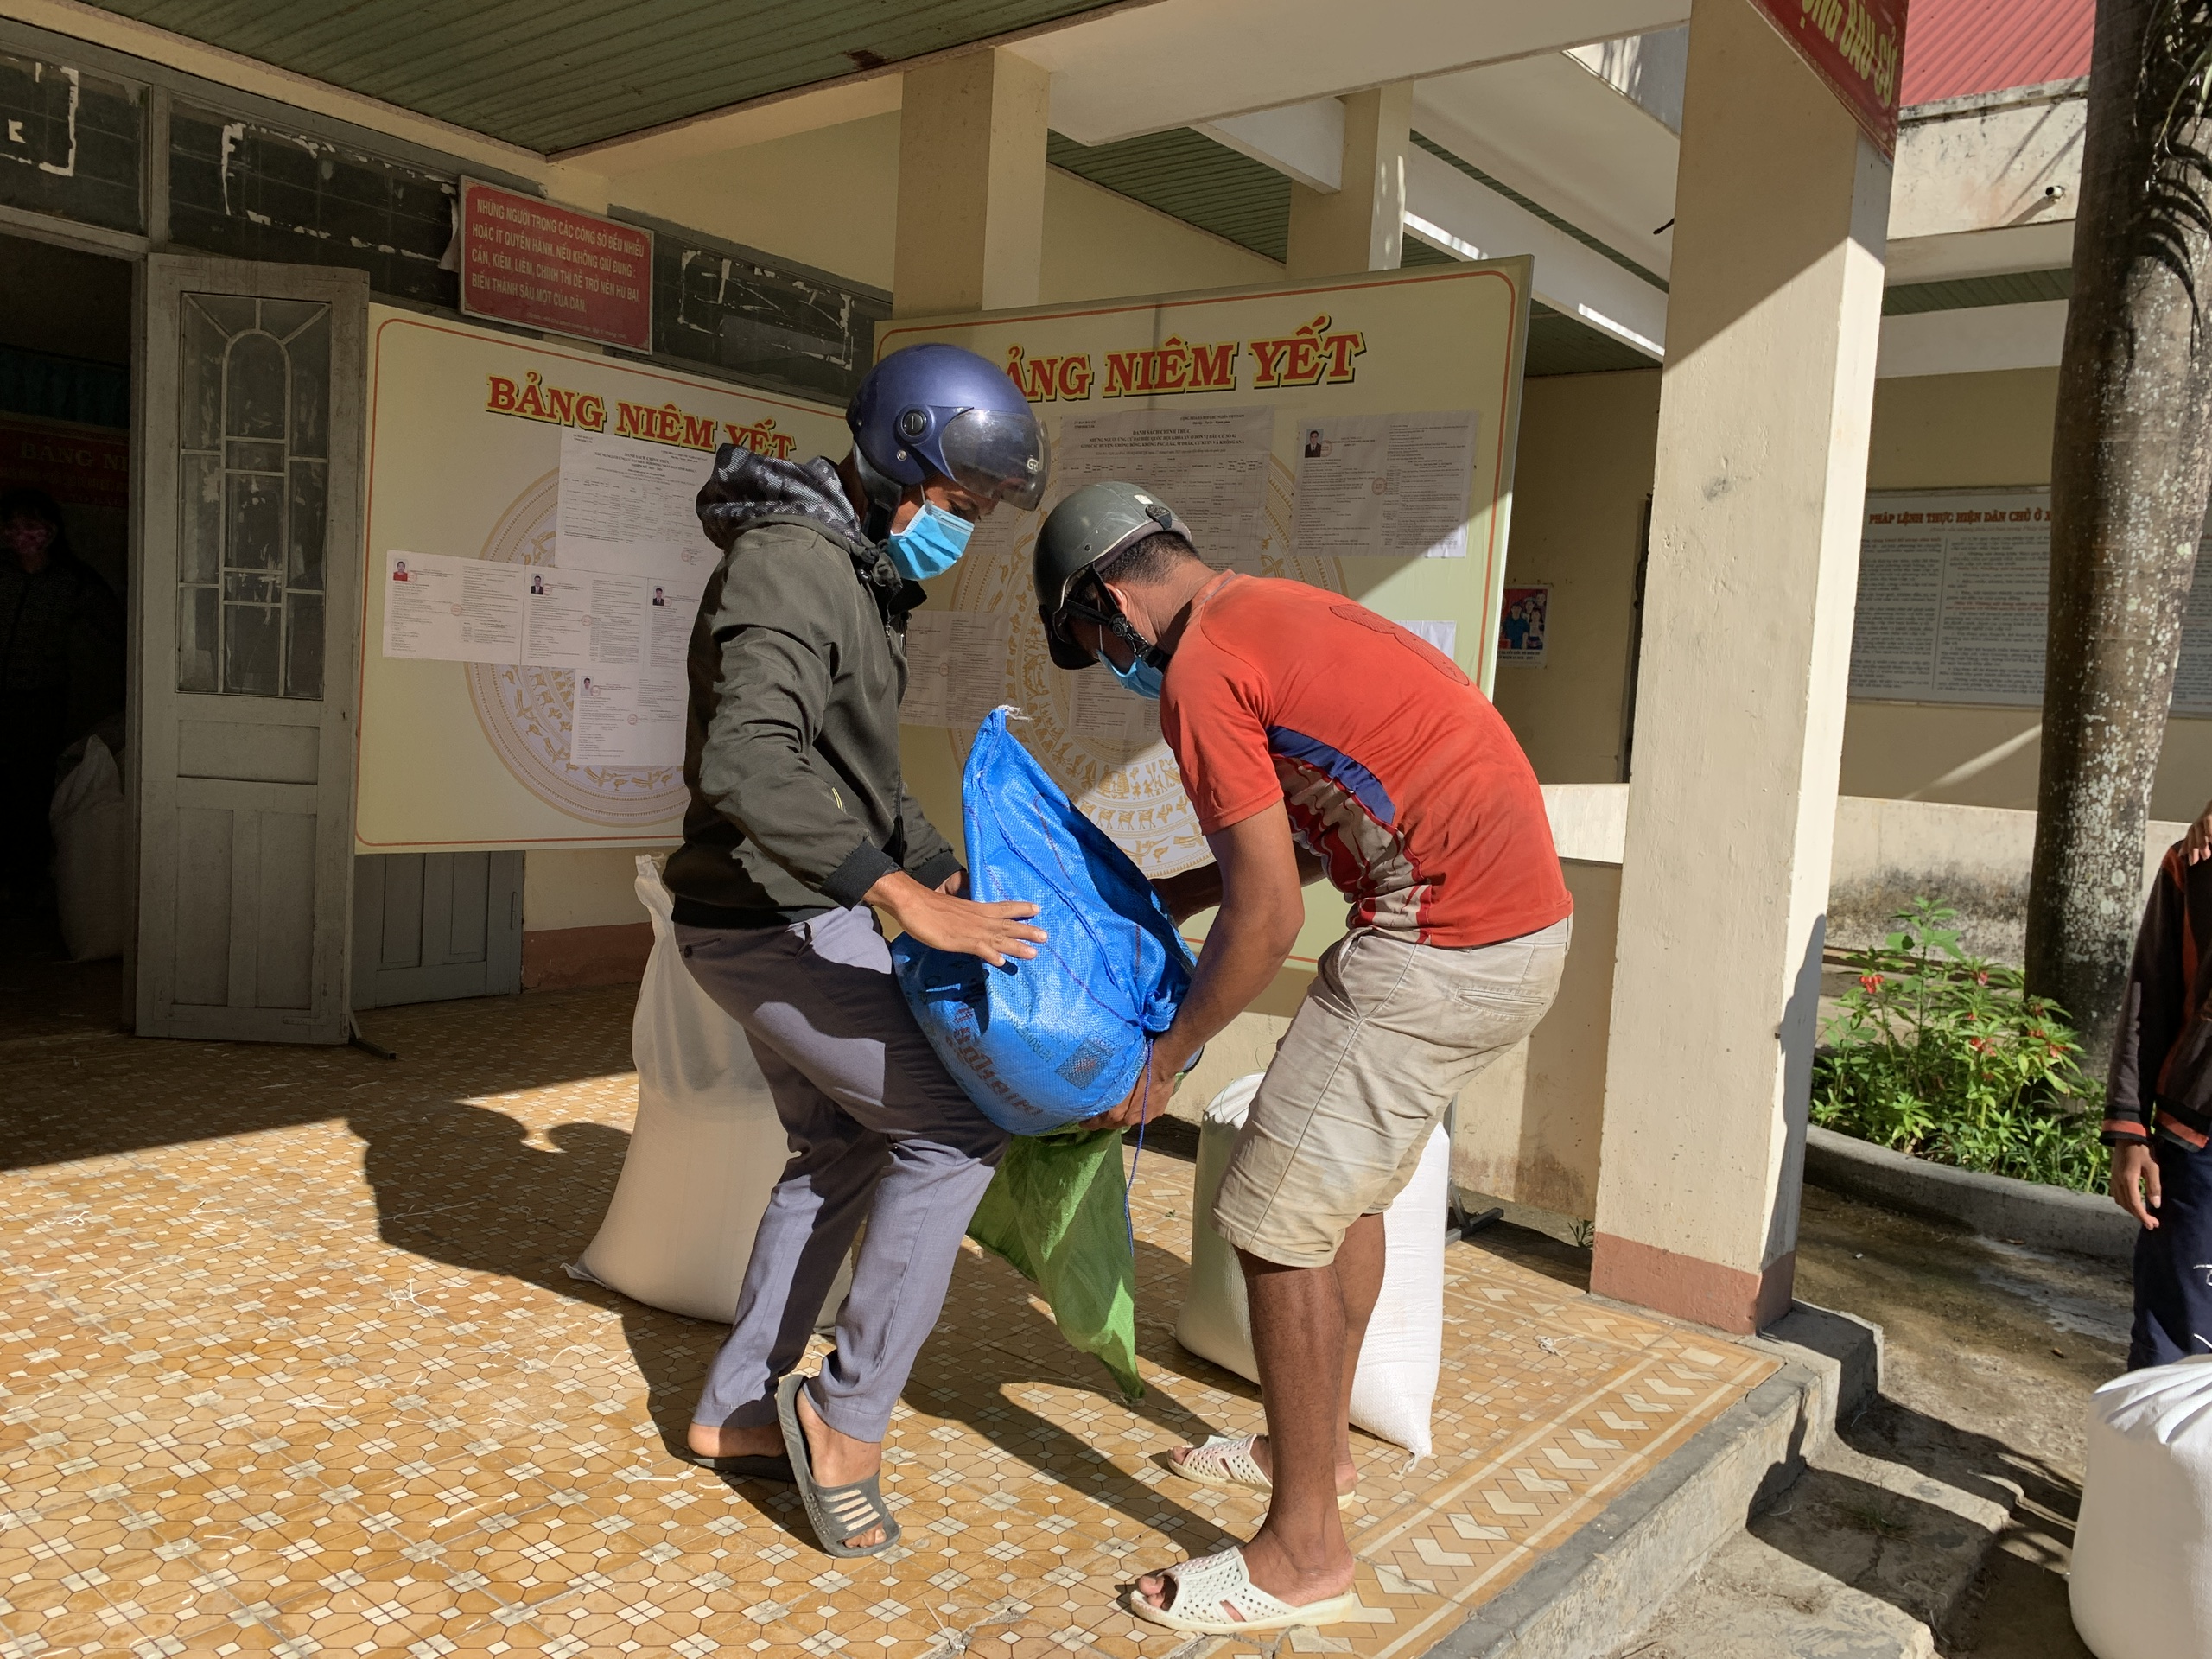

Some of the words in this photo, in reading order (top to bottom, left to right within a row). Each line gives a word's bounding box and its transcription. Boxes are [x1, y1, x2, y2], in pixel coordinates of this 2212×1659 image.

[472, 222, 494, 243] HOẶC
[573, 250, 598, 269] KHÔNG
[531, 214, 556, 233] TRONG
[558, 220, 574, 238] CÁC
[575, 226, 595, 245] CÔNG
[1005, 343, 1093, 402] ẢNG
[1102, 334, 1240, 398] NIÊM
[1249, 312, 1366, 389] YẾT
[486, 371, 607, 433] BẢNG
[614, 401, 718, 453] NIÊM
[102, 453, 129, 472] NI
[1868, 511, 1895, 524] PHÁP
[1984, 509, 2006, 522] DÂN
[2009, 507, 2031, 522] CHỦ
